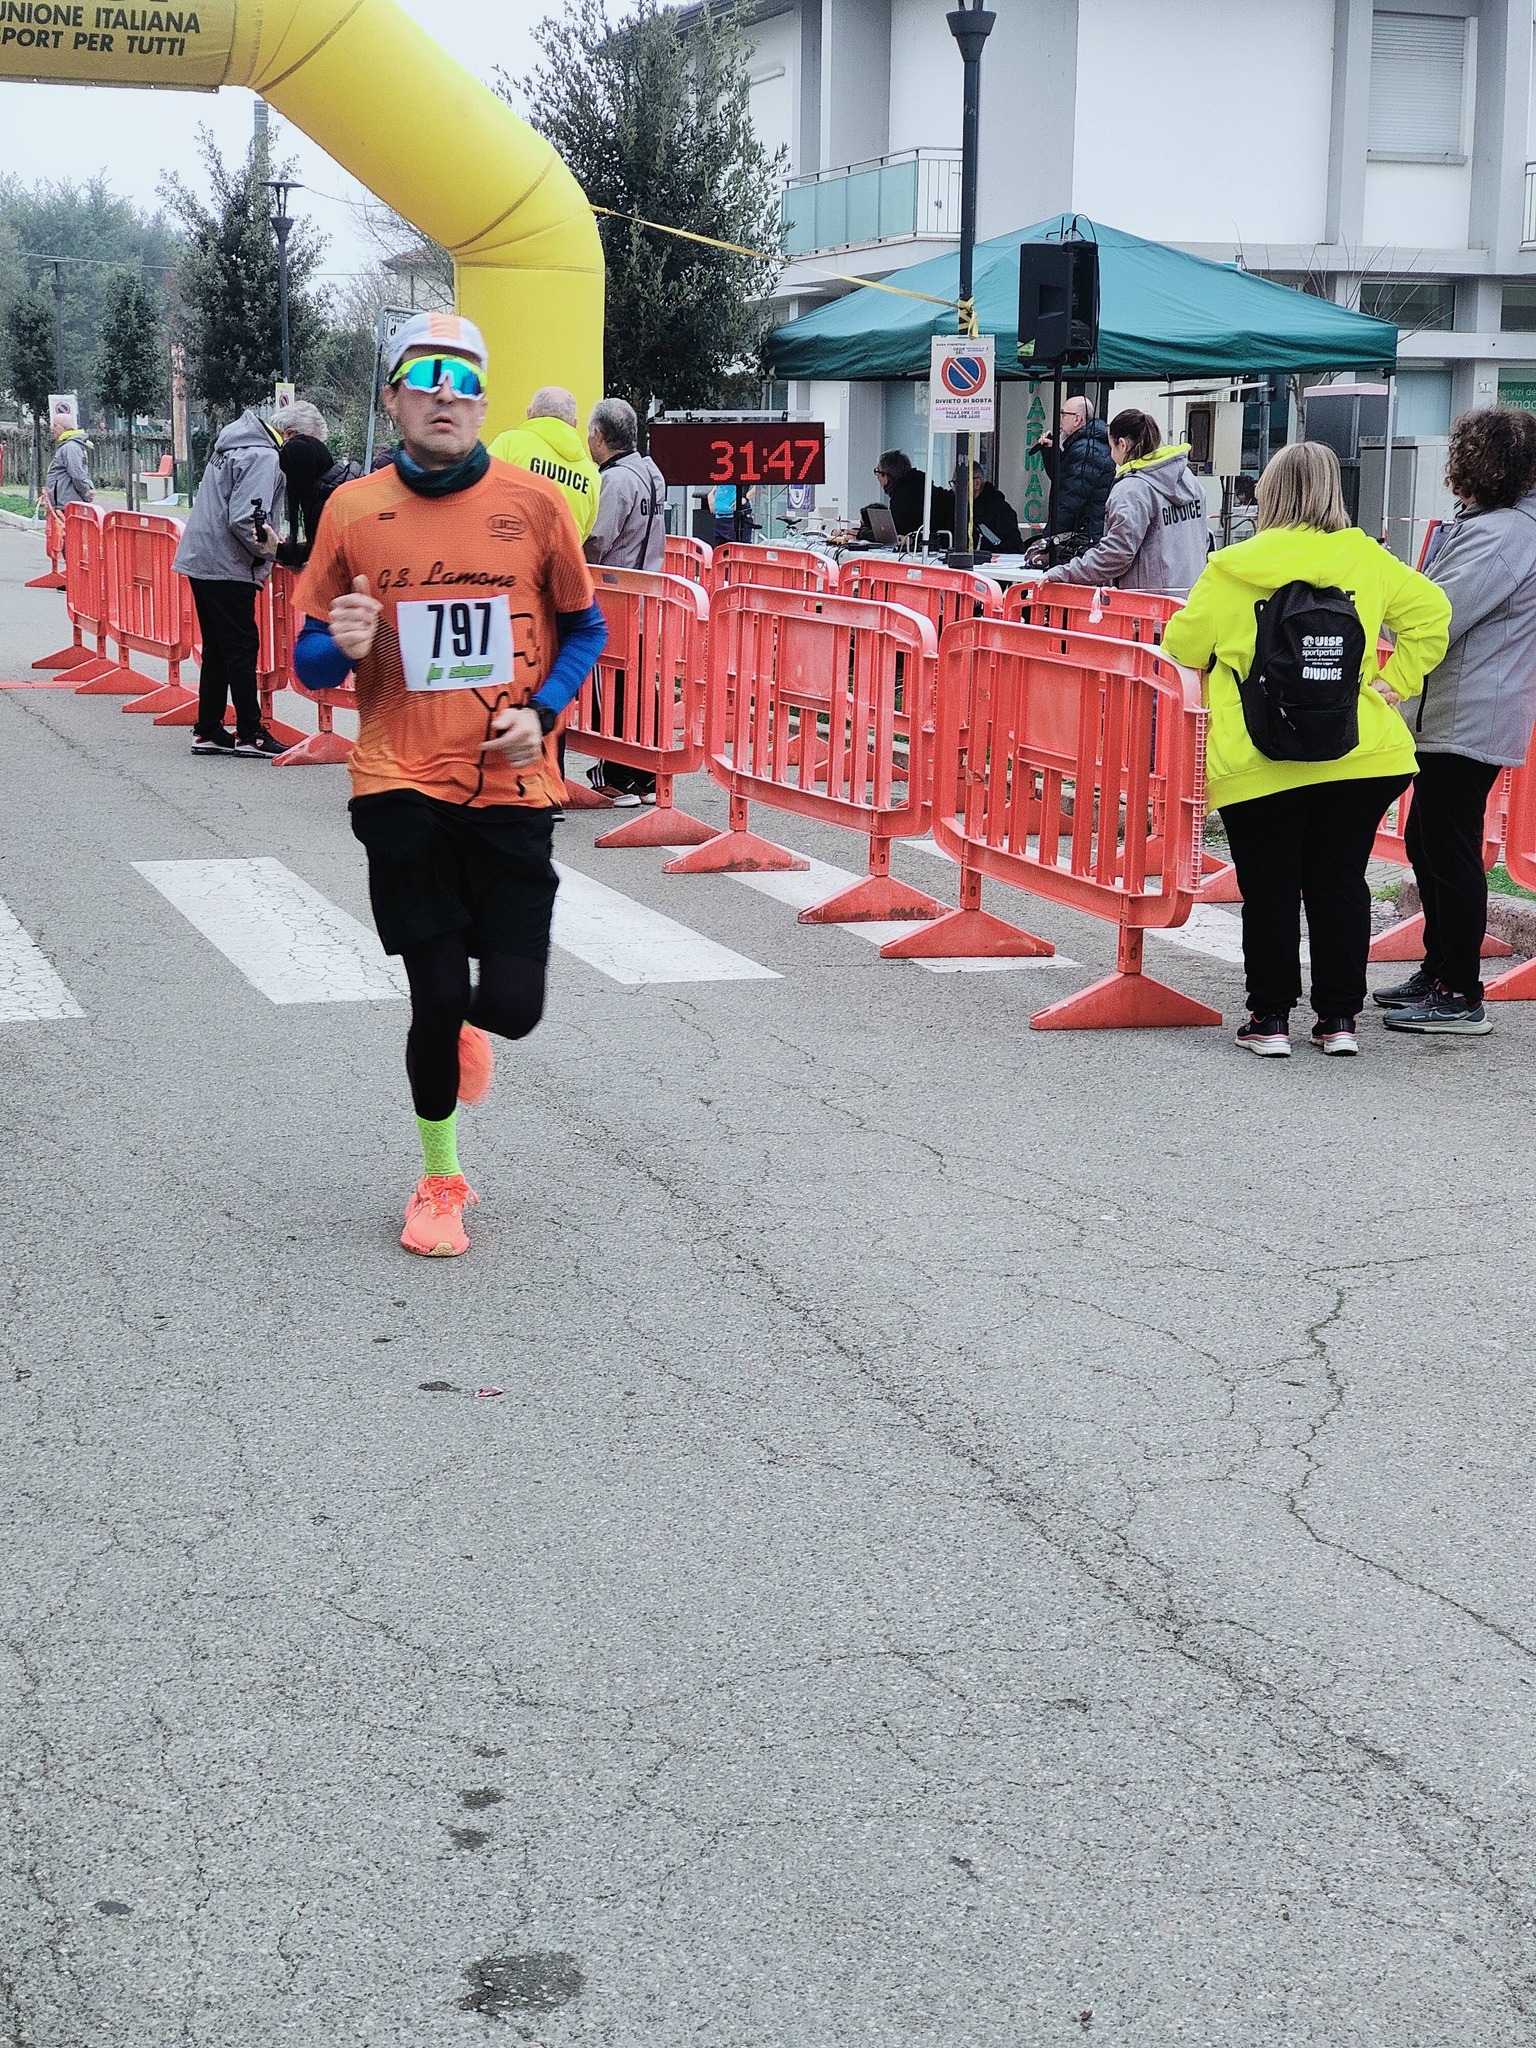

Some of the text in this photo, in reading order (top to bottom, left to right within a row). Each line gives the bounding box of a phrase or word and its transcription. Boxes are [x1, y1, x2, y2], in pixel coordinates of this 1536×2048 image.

[95, 7, 201, 34] ITALIANA
[0, 27, 186, 56] PORT PER TUTTI
[709, 440, 820, 481] 31:47
[530, 457, 590, 495] GIUDICE
[1162, 500, 1202, 526] GIUDICE
[421, 560, 517, 588] Lamone
[428, 602, 491, 658] 797
[1314, 636, 1344, 647] UISP
[1302, 649, 1344, 657] sportpertutti
[1302, 666, 1342, 680] GIUDICE
